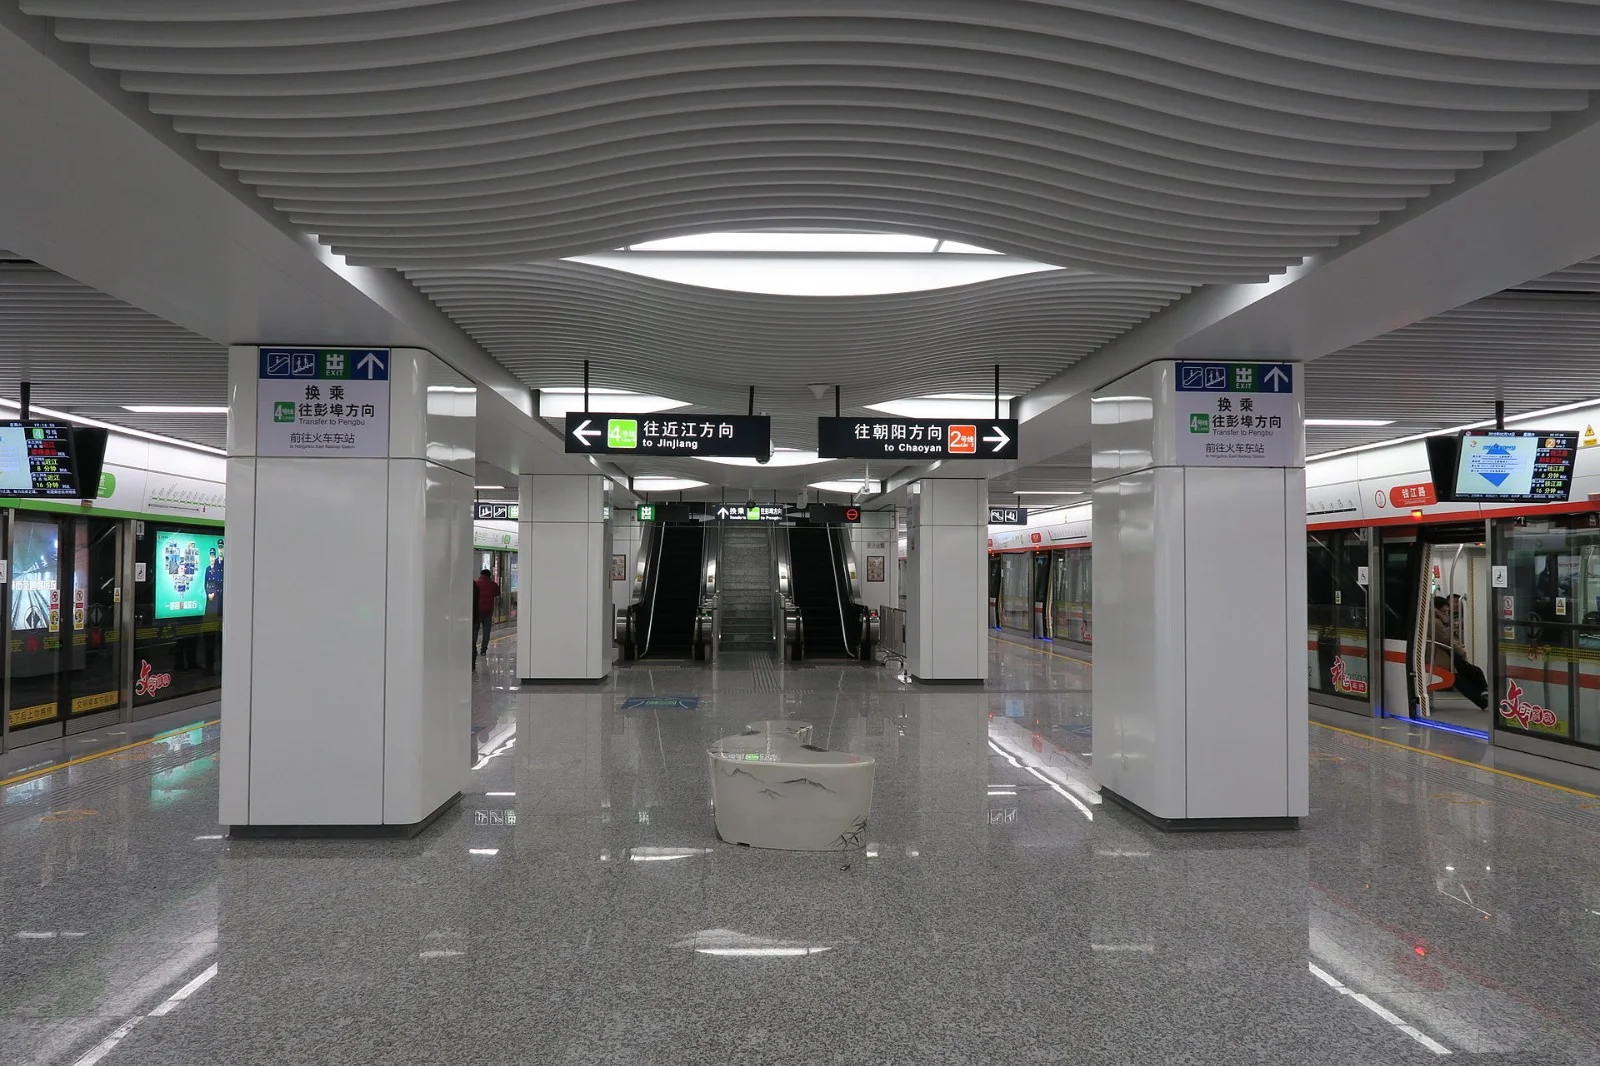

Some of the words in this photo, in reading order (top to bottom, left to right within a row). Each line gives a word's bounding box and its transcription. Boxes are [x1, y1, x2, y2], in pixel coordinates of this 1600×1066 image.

[326, 369, 344, 377] EXIT
[298, 403, 375, 418] 往彭埠方向
[1212, 414, 1281, 429] 往彭埠方向
[643, 420, 734, 439] 往近江方向
[854, 423, 942, 441] 往朝阳方向
[1248, 429, 1274, 438] Pengbu
[290, 432, 355, 444] 前往火车东站
[642, 439, 653, 447] to
[657, 439, 698, 450] Jinjiang
[884, 444, 895, 452] to
[898, 443, 942, 453] Chaoyan
[1205, 442, 1265, 454] 前往火车东站
[1401, 486, 1426, 499] 钱江路
